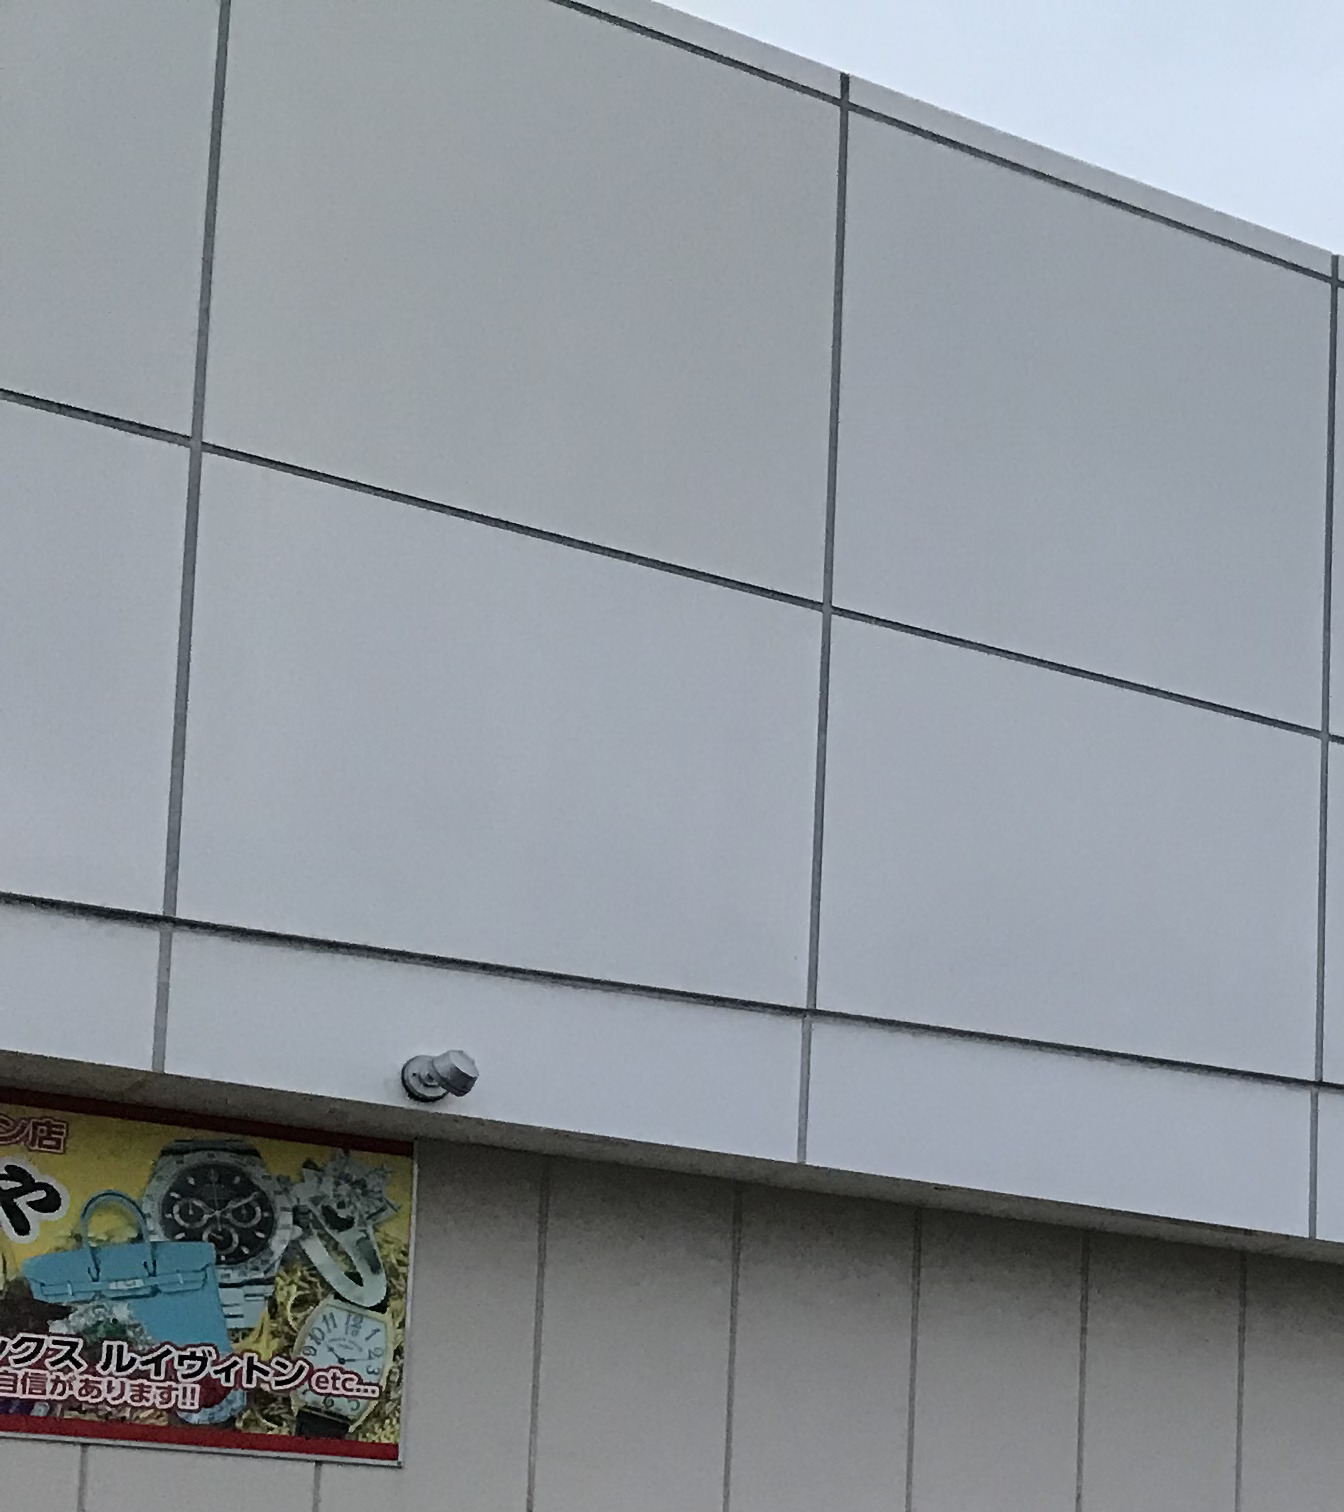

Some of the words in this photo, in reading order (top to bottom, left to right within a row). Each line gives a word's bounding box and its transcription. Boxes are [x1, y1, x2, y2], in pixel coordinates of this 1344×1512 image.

[0, 1336, 84, 1371] クス
[100, 1343, 309, 1389] ルイヴィトン
